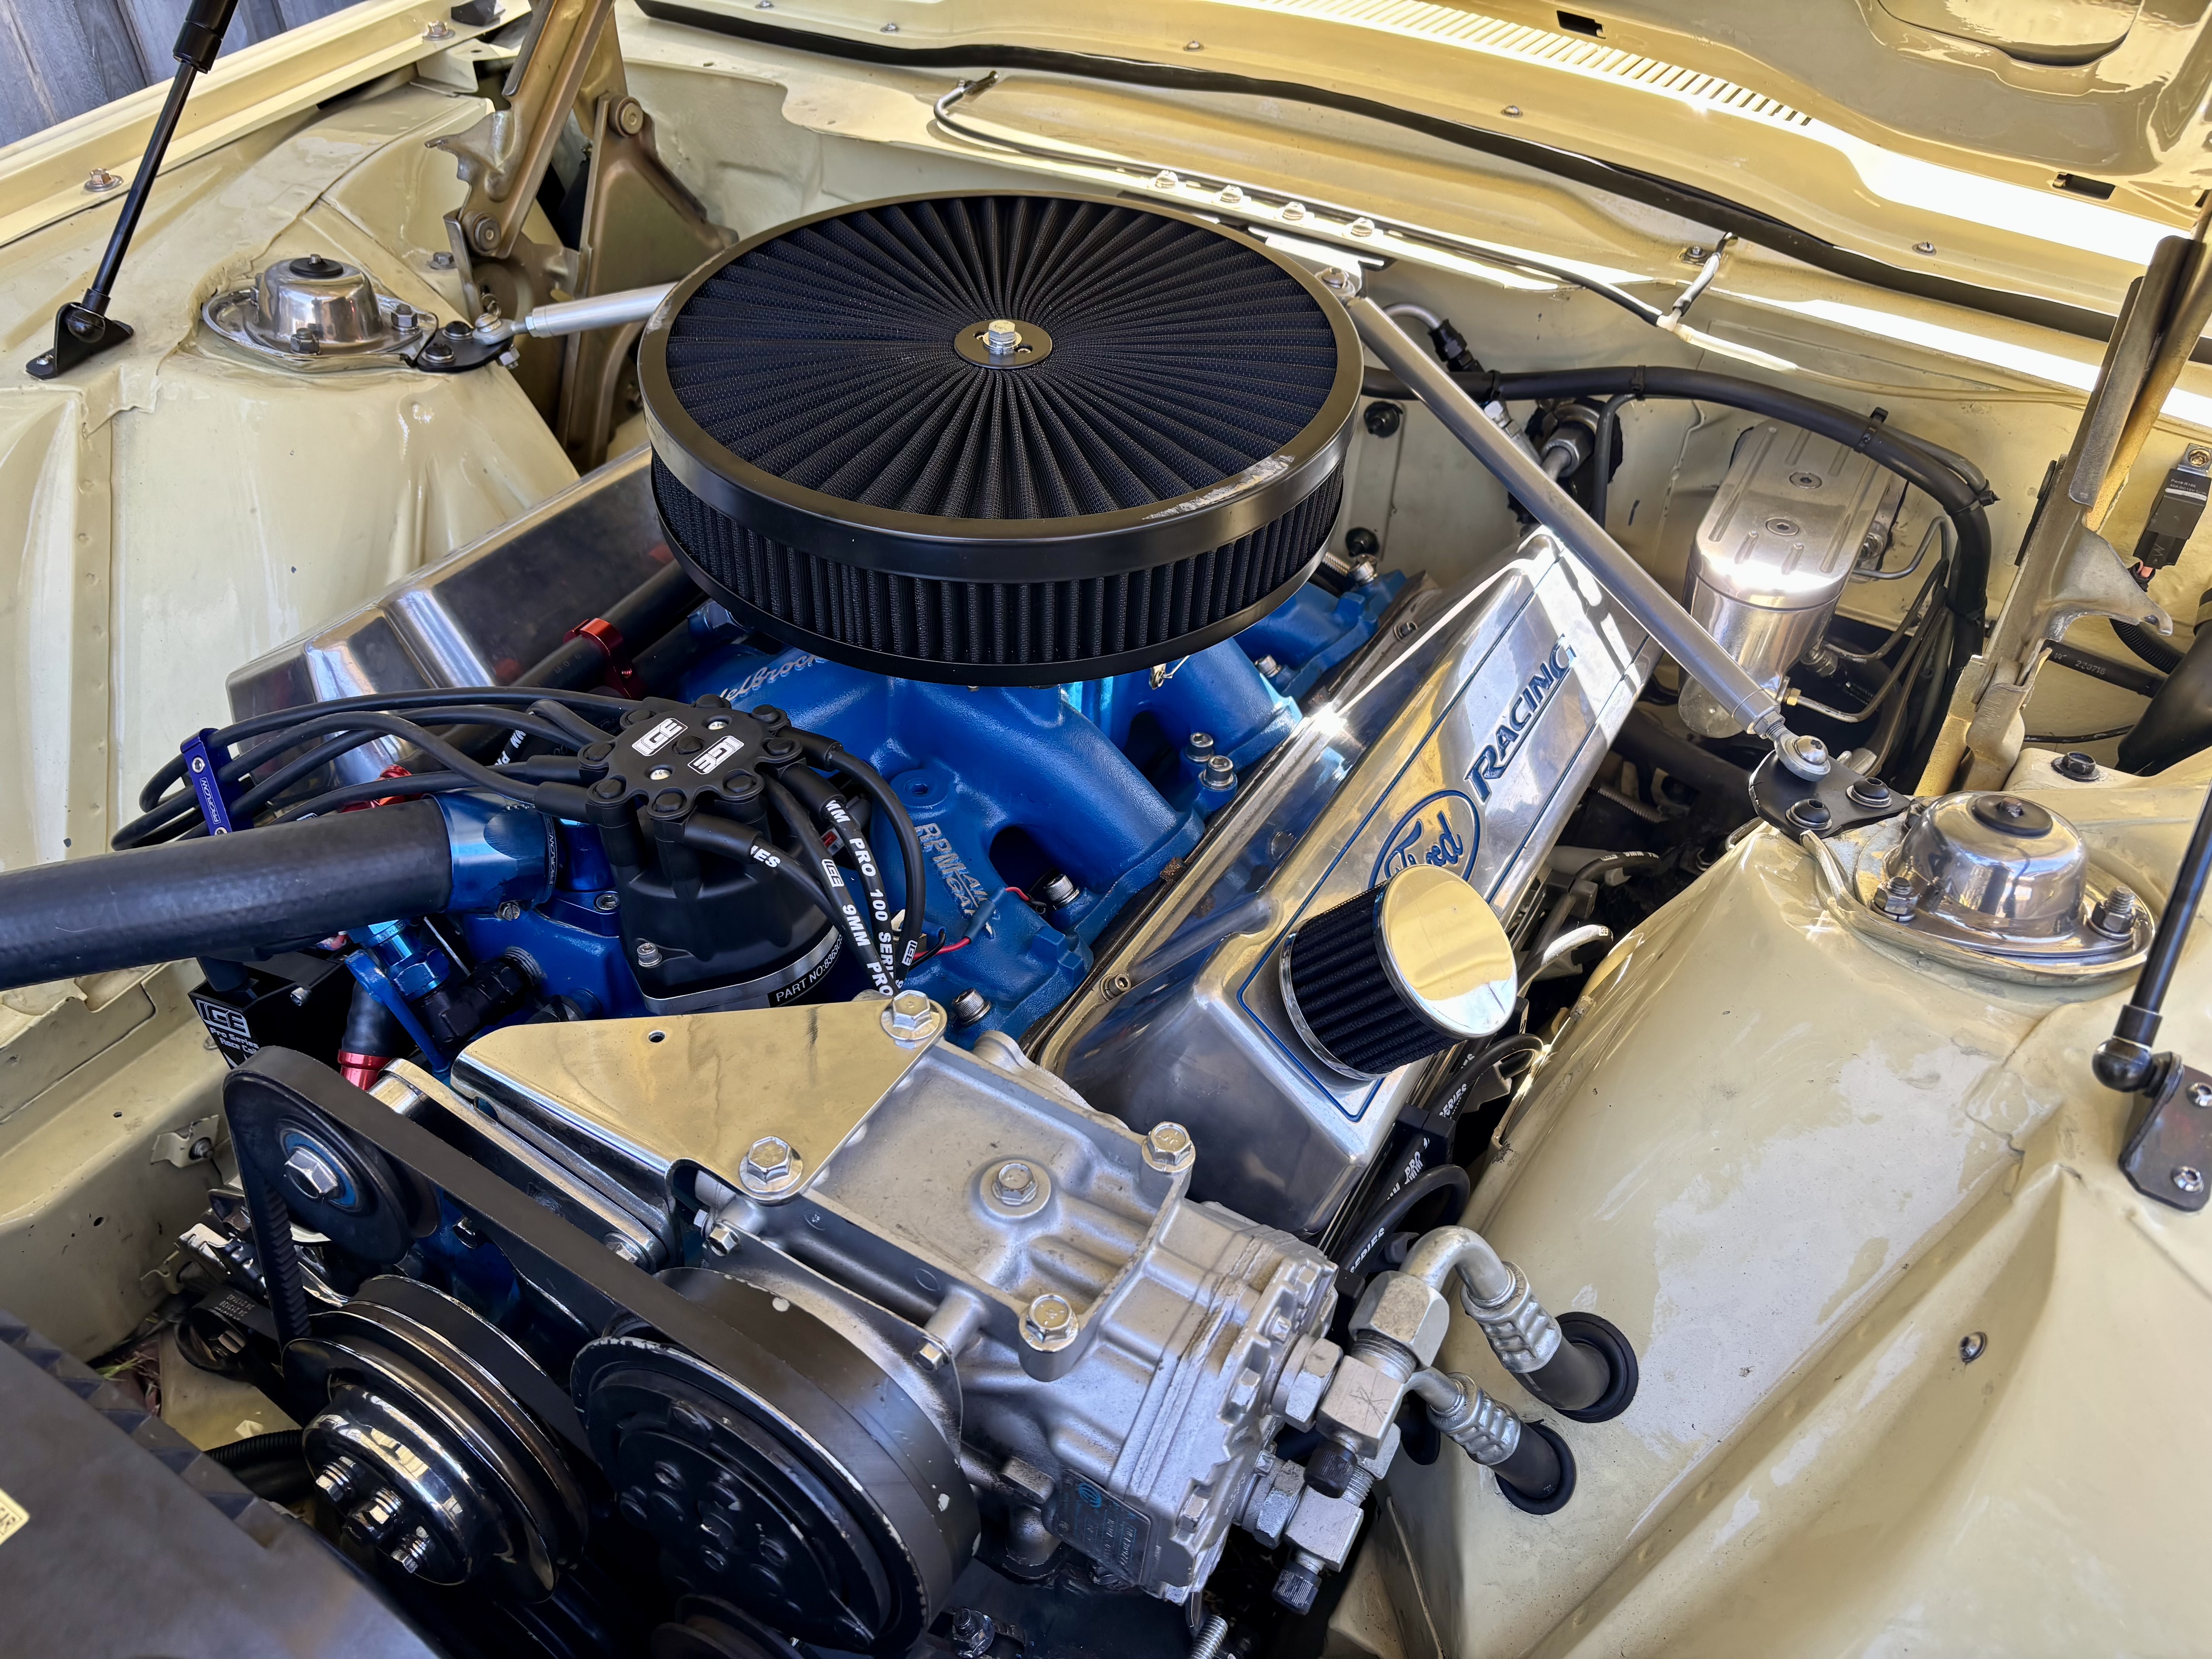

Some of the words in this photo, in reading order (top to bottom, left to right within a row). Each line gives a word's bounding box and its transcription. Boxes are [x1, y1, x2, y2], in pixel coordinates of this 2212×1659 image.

[1465, 633, 1577, 803] RACING
[200, 778, 220, 823] PROFLOW
[914, 823, 967, 874] RPM
[849, 838, 875, 877] PRO
[870, 889, 888, 921] 100
[842, 904, 871, 946] 9MM
[867, 962, 894, 996] PRO
[776, 978, 807, 1001] PART
[196, 1000, 251, 1038] ICE
[210, 1027, 228, 1038] Pro
[229, 1033, 259, 1049] Series
[219, 1037, 240, 1050] Race
